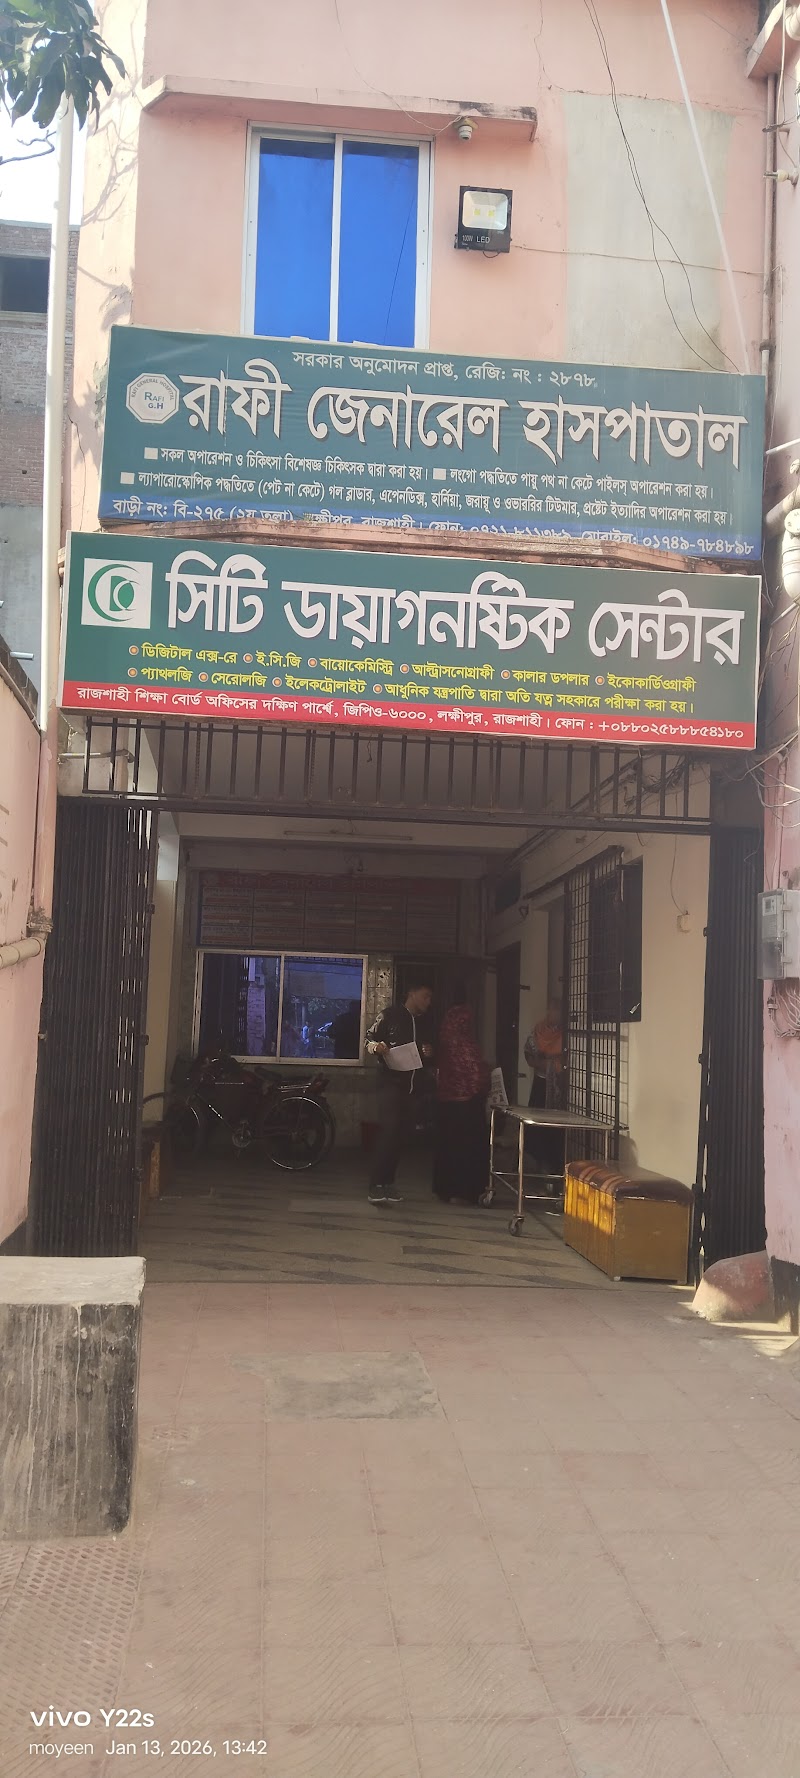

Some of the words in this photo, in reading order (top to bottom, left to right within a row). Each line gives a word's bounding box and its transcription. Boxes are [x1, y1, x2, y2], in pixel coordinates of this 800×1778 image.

[292, 352, 345, 369] সরকার
[349, 356, 420, 376] অনুমোদন
[512, 368, 531, 384] নং
[178, 358, 292, 438] রাফী
[308, 384, 510, 454] জেনারেল
[518, 394, 748, 470] হাসপাতাল
[161, 448, 186, 462] সকল
[187, 450, 233, 466] অপারেশন
[235, 454, 243, 466] ও
[246, 450, 282, 470] চিকিৎসা
[324, 456, 365, 475] চিকিৎসক
[367, 463, 386, 477] দ্বারা
[388, 464, 407, 479] করা
[479, 467, 518, 485] পদ্ধতিতে
[541, 474, 556, 488] পথ
[557, 475, 568, 489] না
[571, 473, 594, 490] কেটে
[630, 480, 673, 496] অপারেশন
[674, 483, 692, 497] করা
[113, 496, 143, 517] বাড়ী
[215, 474, 256, 493] পদ্ধতিতে
[258, 478, 282, 498] (পেট
[284, 482, 295, 497] না
[298, 480, 325, 502] কেটে)
[329, 485, 344, 500] গল
[493, 497, 500, 508] ও
[648, 506, 692, 522] অপারেশন
[693, 510, 712, 523] করা
[165, 550, 268, 633] সিটি
[281, 571, 574, 654] ডায়াগনষ্টিক
[588, 588, 745, 665] সেন্টার
[141, 642, 193, 660] ডিজিটাল
[196, 650, 238, 663] এক্স-রে
[512, 670, 548, 683] কালার
[550, 673, 590, 686] ডপলার
[77, 686, 132, 702] রাজশাহী
[134, 688, 168, 704] শিক্ষা
[172, 692, 203, 705] বোর্ড
[205, 693, 258, 709] অফিসের
[261, 697, 298, 712] দক্ষিণ
[555, 718, 585, 730] ফোন
[141, 666, 193, 682] প্যাথলজি
[211, 671, 268, 687] সেরোলজি
[285, 673, 367, 694] ইলেকট্রোলাইট
[384, 682, 430, 700] আধুনিক
[478, 689, 503, 702] দ্বারা
[505, 688, 532, 703] অতি
[556, 694, 601, 708] সহকারে
[604, 693, 641, 710] পরীক্ষা
[643, 699, 667, 711] করা
